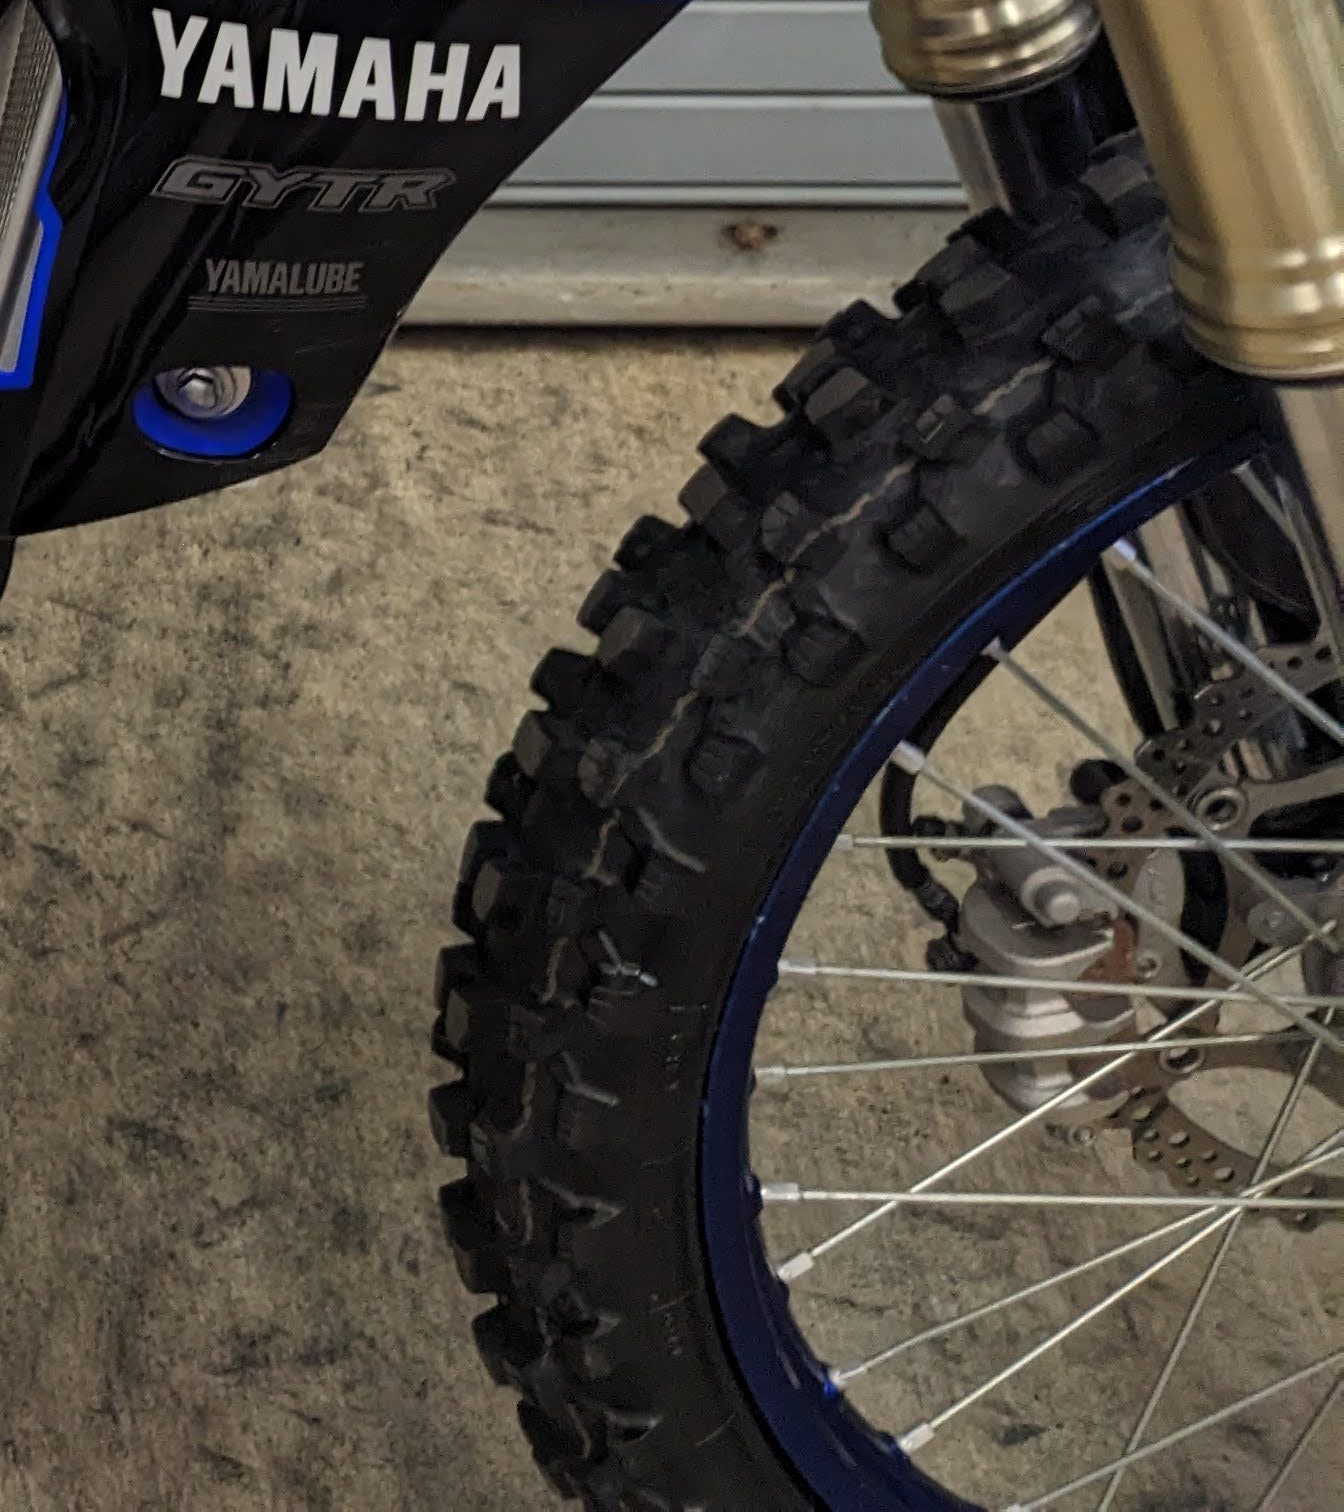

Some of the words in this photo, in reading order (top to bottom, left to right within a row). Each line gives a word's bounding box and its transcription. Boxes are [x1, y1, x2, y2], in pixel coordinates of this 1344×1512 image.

[152, 8, 521, 122] YAMAHA
[150, 155, 456, 213] GYTR
[205, 258, 365, 295] YAMALUBE
